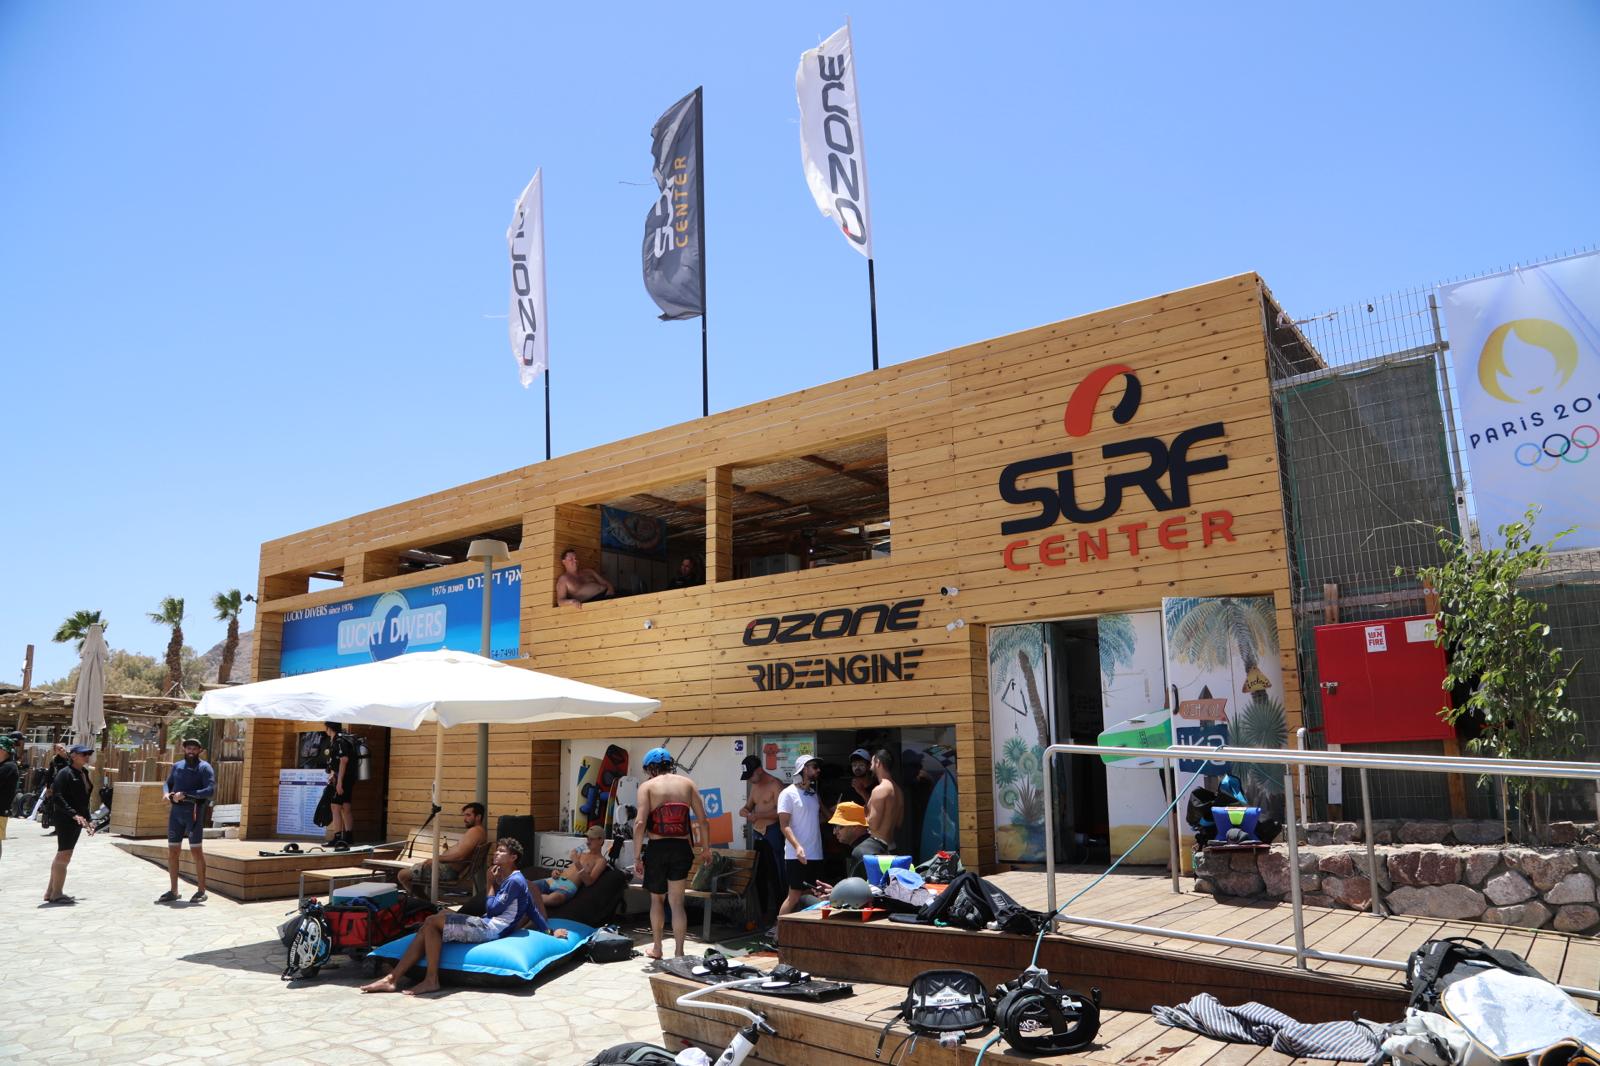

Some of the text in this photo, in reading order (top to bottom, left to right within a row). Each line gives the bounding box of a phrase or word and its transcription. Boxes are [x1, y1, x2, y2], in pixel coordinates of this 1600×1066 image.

[817, 53, 867, 245] OZONE
[674, 155, 689, 248] CENTER
[511, 211, 537, 366] OZON
[1553, 393, 1600, 420] 20
[998, 421, 1229, 536] SURF
[1002, 509, 1237, 571] CENTER
[283, 602, 354, 623] LUCKY DIVERS since 1976
[431, 585, 446, 597] 1976
[340, 609, 443, 649] LUCKY DIVERS
[742, 598, 925, 646] OZONE
[1368, 638, 1384, 647] FIRE
